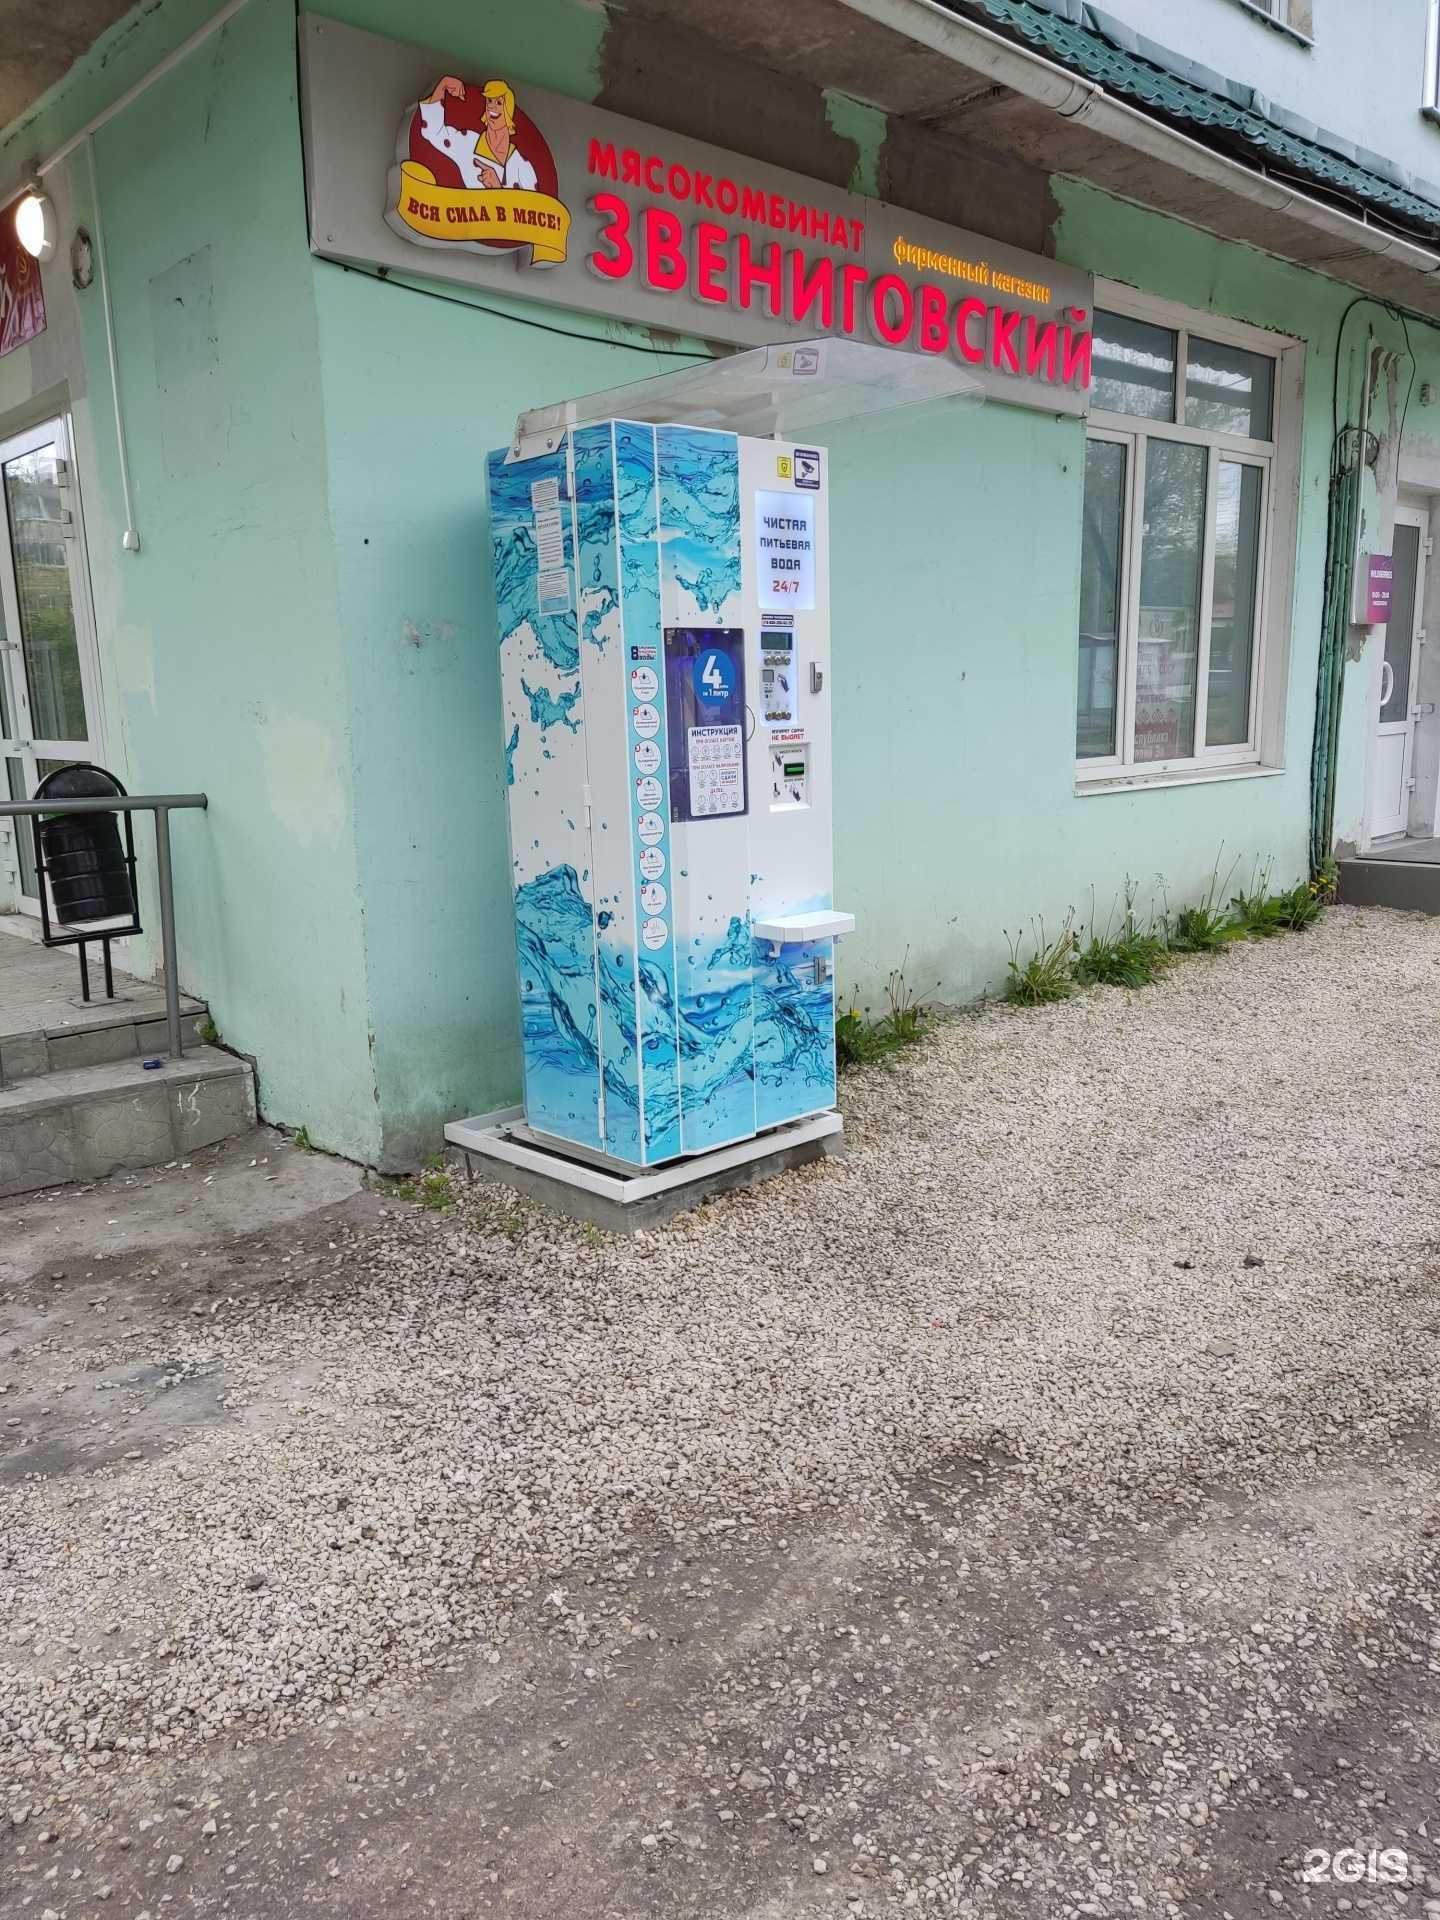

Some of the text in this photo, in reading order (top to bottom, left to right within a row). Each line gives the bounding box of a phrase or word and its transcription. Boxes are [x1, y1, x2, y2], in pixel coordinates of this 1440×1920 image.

[587, 137, 865, 254] МЯСОКОМБИНАТ
[407, 197, 561, 231] ВСЯ СИЛА В МЯСЕ!
[893, 235, 1051, 304] фирменный магазин
[587, 192, 1093, 391] ЗВЕНИГОВСКИЙ
[763, 516, 807, 531] ЧИСТАЯ
[760, 537, 811, 551] ПИТЬЕВАЯ
[771, 558, 801, 570] ВОДА
[772, 580, 800, 593] 24/7
[702, 655, 722, 689] 4
[691, 727, 738, 737] ИНСТРУКЦИЯ
